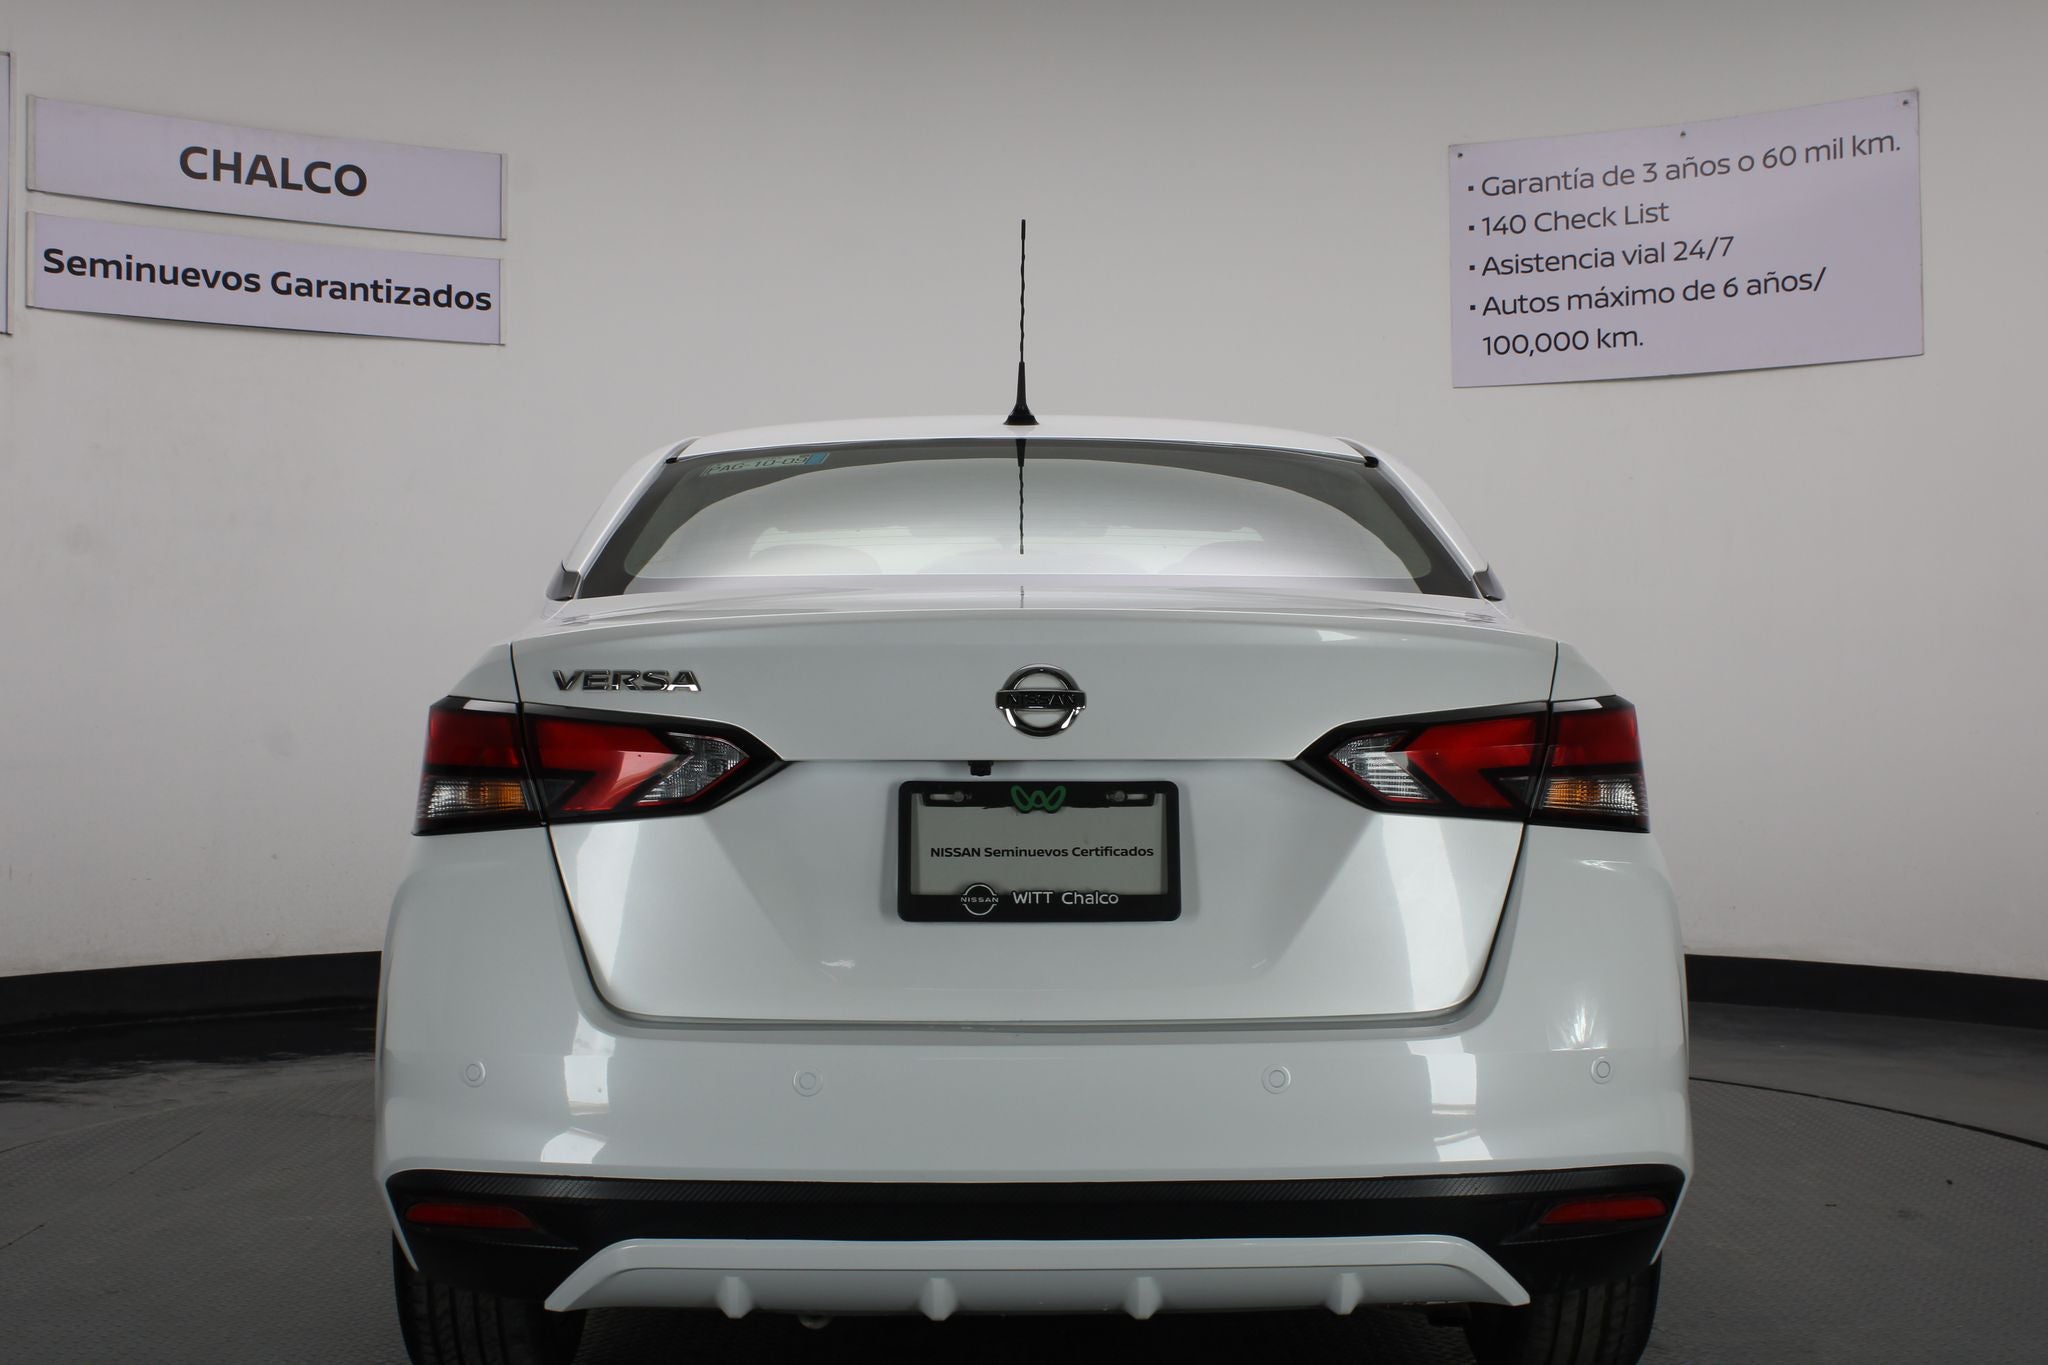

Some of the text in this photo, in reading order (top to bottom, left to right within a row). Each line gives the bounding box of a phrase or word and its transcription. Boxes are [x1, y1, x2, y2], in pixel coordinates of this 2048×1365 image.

[180, 146, 367, 197] CHALCO
[1481, 135, 1900, 197] Garantía de 3 años o 60 mil km.
[1482, 203, 1669, 236] 140 Check List
[1482, 236, 1734, 276] Asistencia vial 24/7
[44, 248, 491, 311] Seminuevos Garantizados
[1482, 267, 1826, 316] Autos máximo de 6 años/
[1483, 328, 1643, 357] 100,000 km.
[553, 669, 702, 692] VERSA
[930, 846, 1154, 858] NISSAN Seminuevos Certificados
[960, 896, 999, 904] NISSAN
[1012, 891, 1119, 905] WITT Chalco
